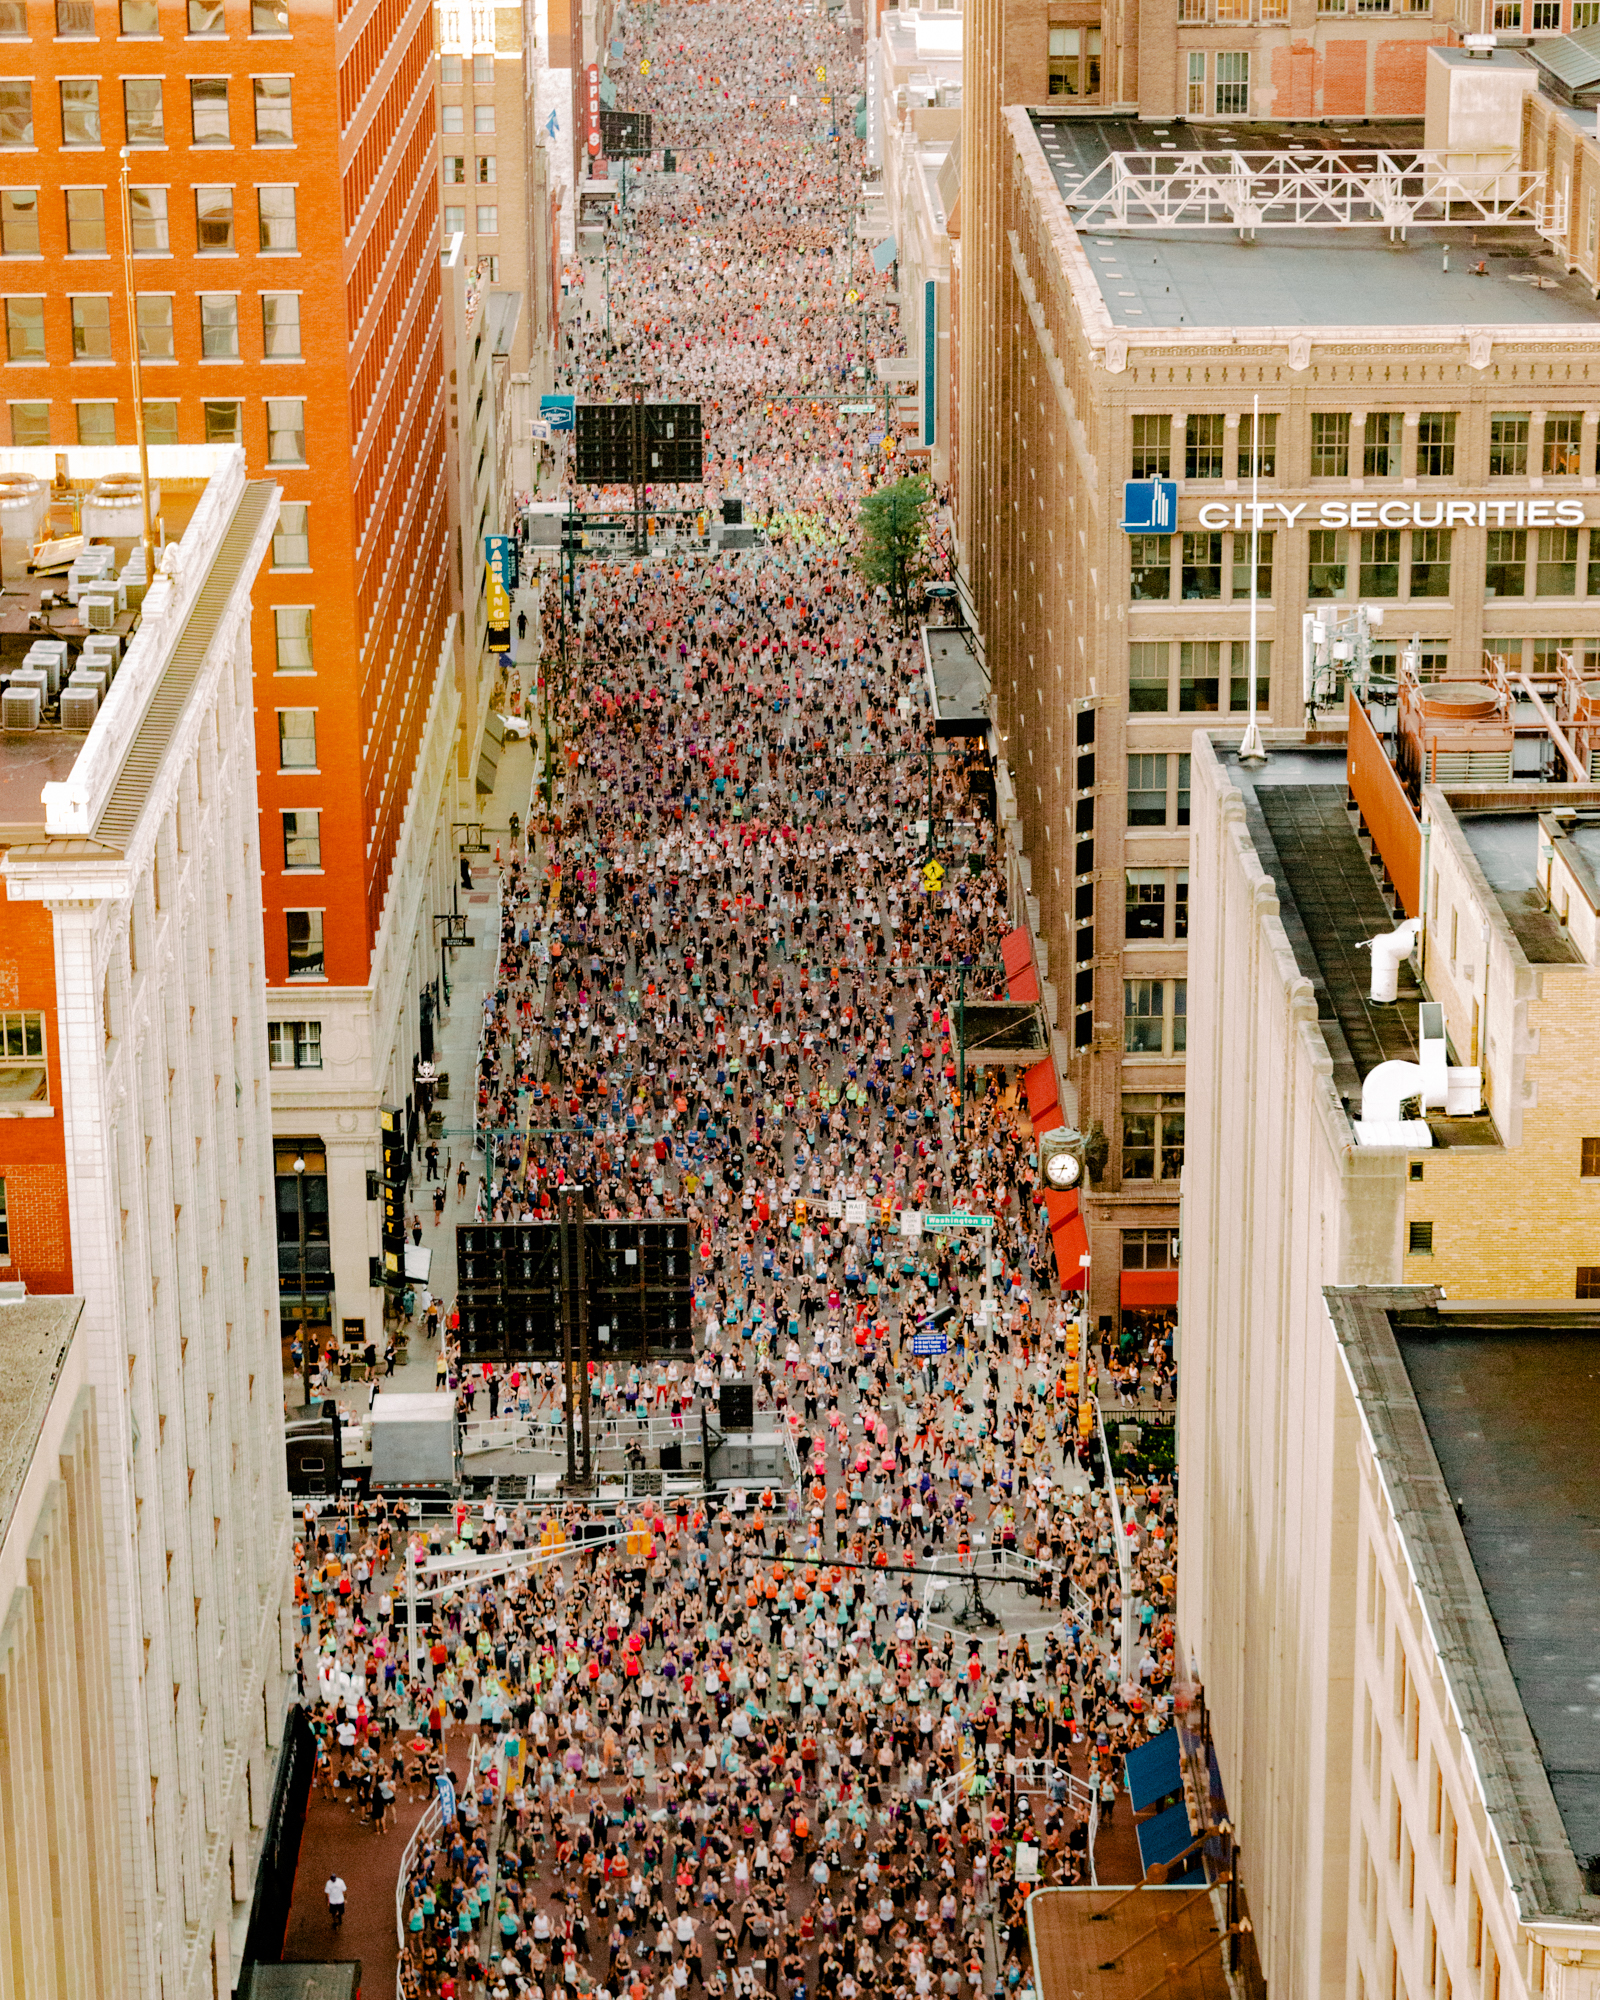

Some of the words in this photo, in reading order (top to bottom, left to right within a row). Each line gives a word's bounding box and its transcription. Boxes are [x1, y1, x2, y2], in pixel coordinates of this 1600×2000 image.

[1198, 502, 1307, 529] CITY
[1319, 500, 1586, 528] SECURITIES
[490, 538, 504, 619] PARKING
